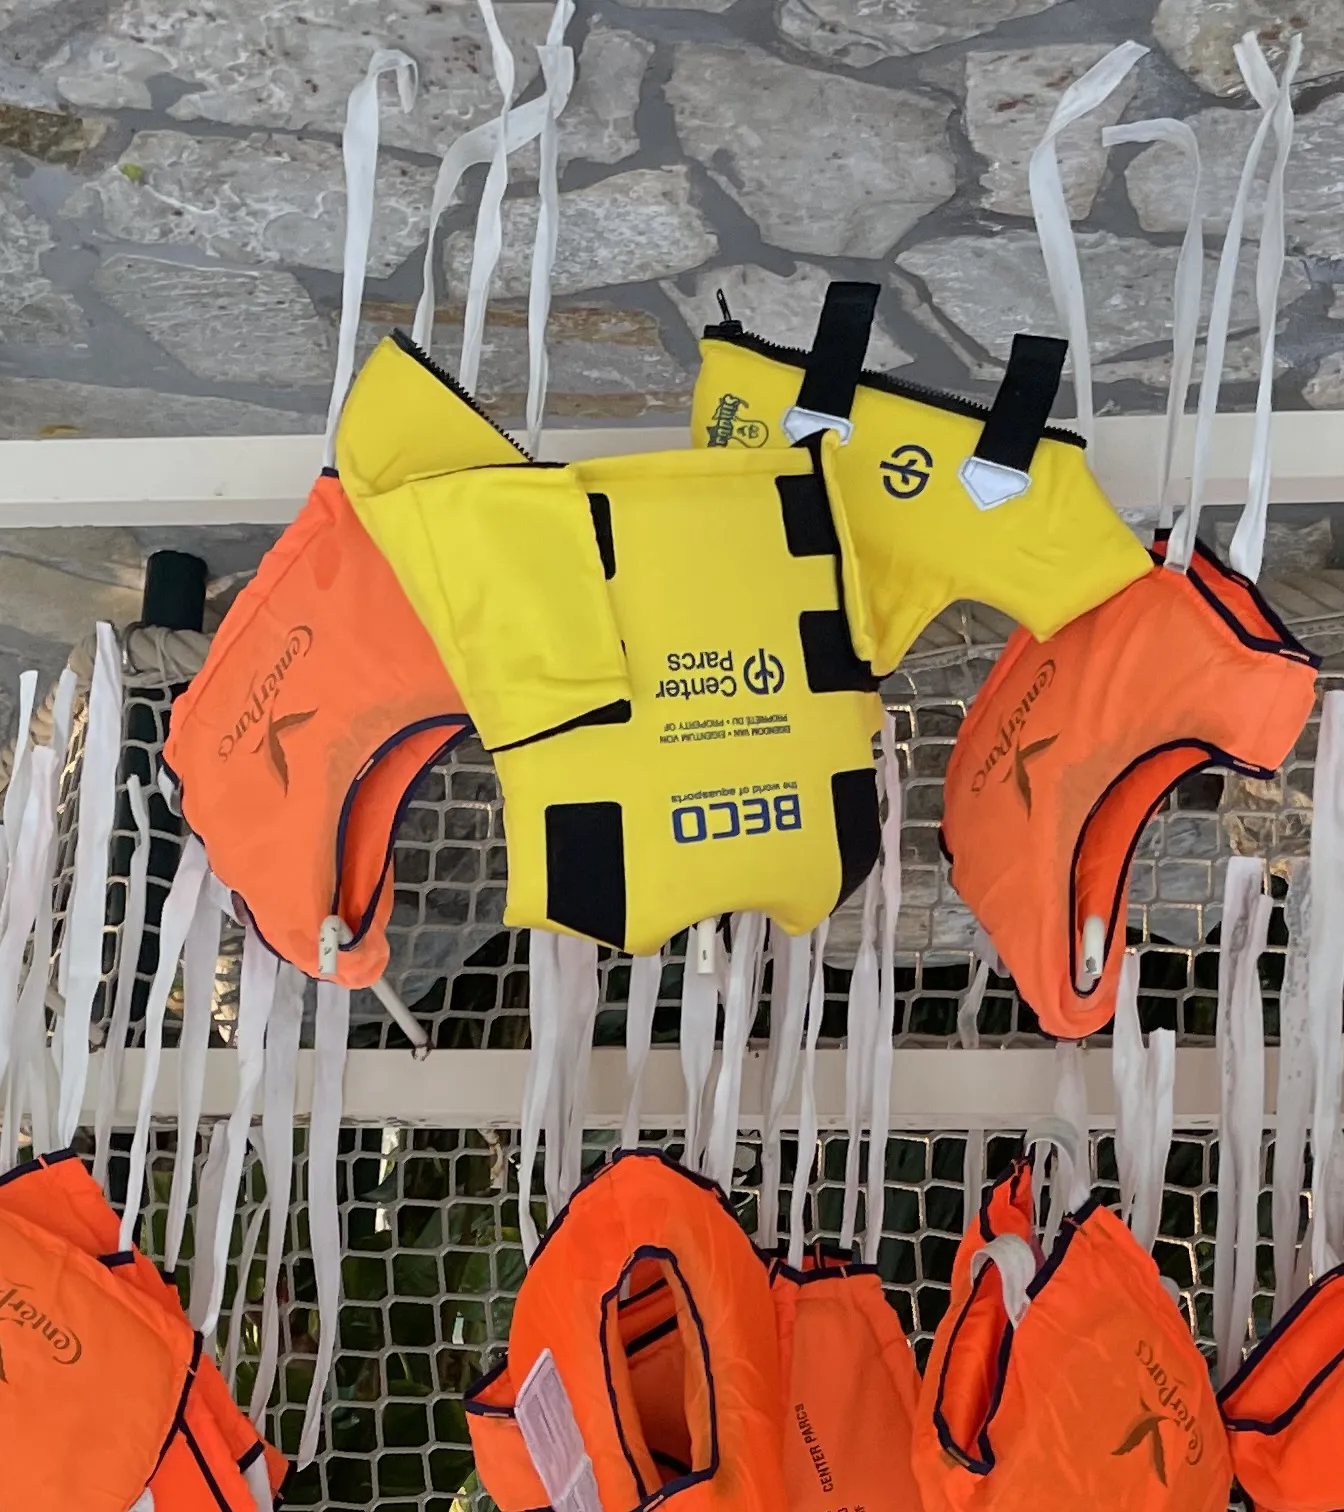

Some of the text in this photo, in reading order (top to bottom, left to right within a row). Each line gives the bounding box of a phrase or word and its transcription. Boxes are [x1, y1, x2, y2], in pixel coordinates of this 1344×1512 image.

[667, 650, 734, 672] Parcs
[656, 675, 737, 700] Center
[664, 723, 676, 732] OF
[678, 719, 724, 730] PROPERTY
[671, 781, 797, 803] the world of aquasports
[672, 794, 802, 843] BECO
[794, 1403, 833, 1493] CENTER PARCS
